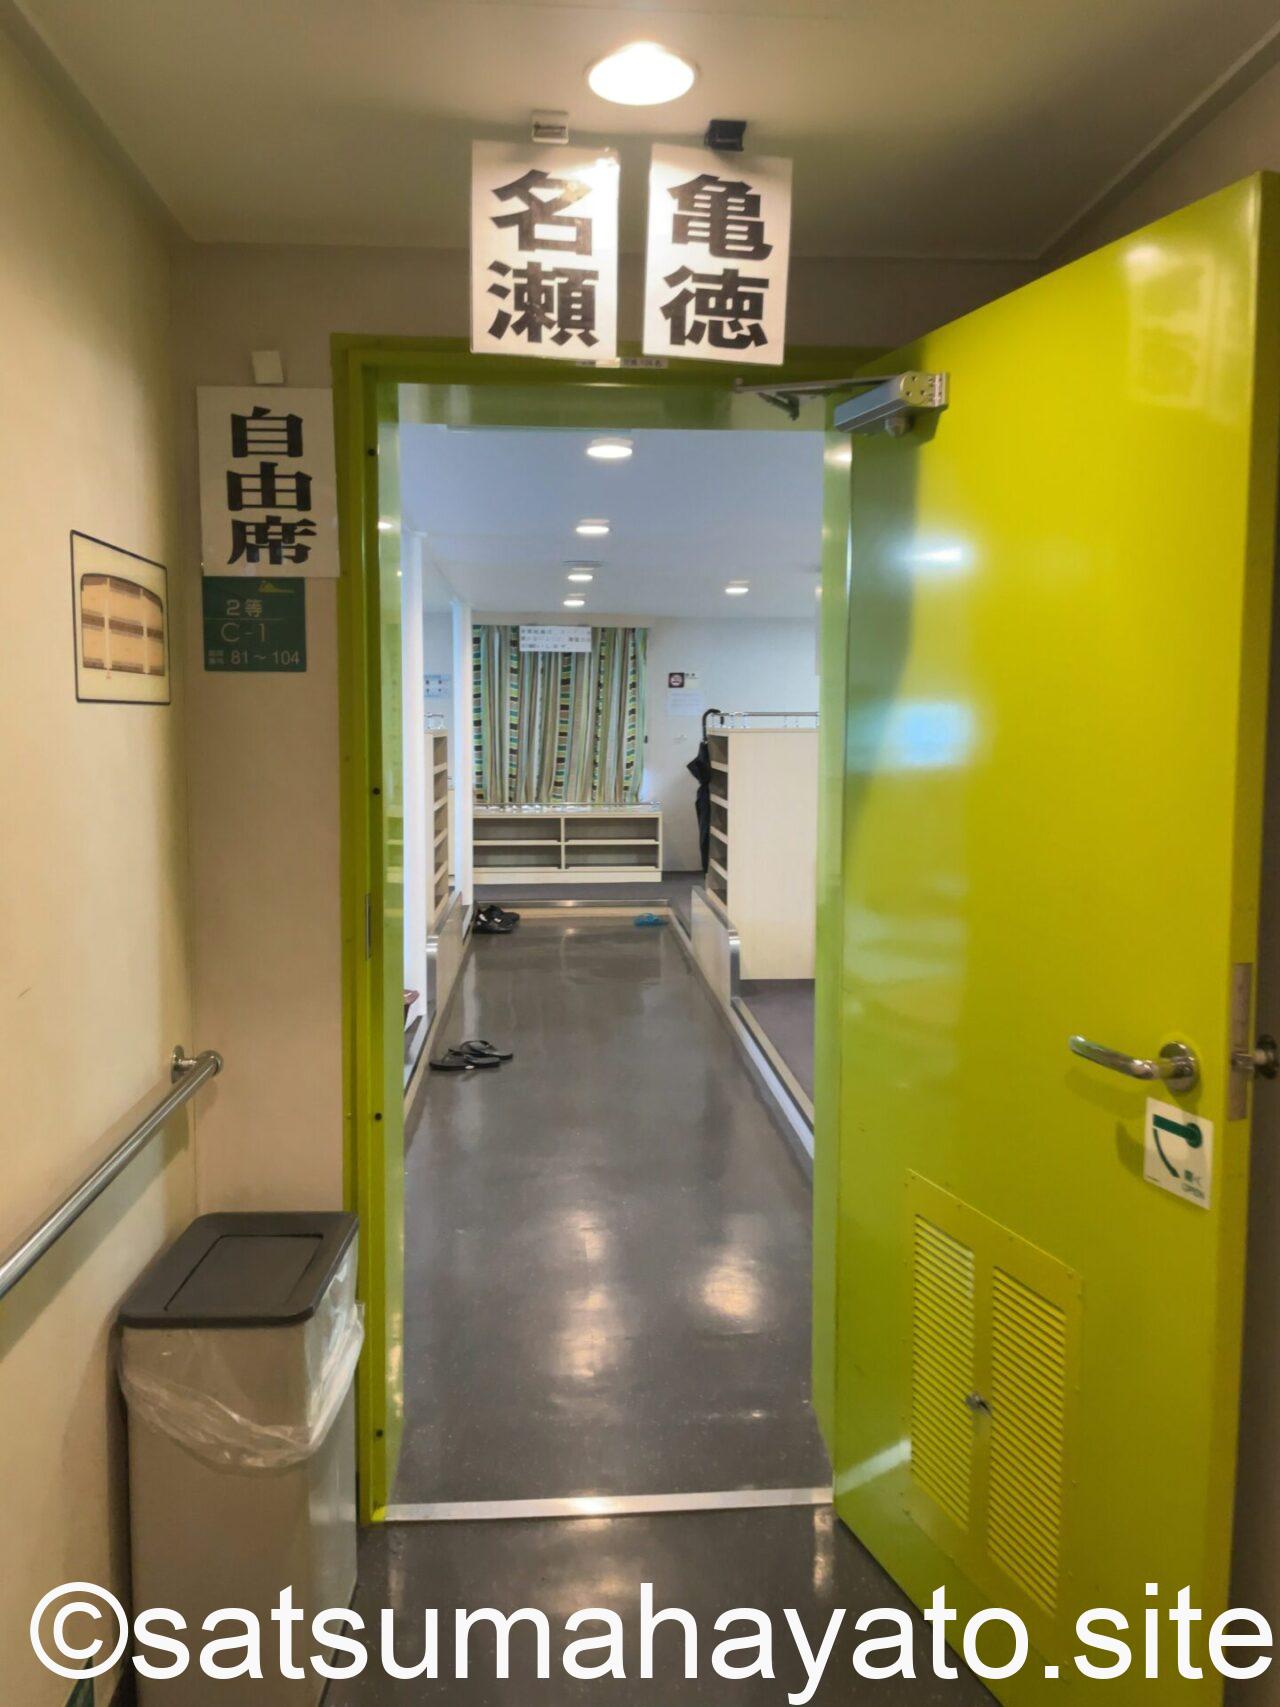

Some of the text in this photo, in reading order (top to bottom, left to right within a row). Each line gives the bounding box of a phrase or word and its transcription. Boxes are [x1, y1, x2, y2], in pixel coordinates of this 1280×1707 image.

[487, 168, 600, 347] 名瀬
[660, 173, 773, 349] 亀徳
[226, 405, 318, 565] 自由席
[220, 622, 265, 642] C-1
[226, 598, 263, 618] 2等
